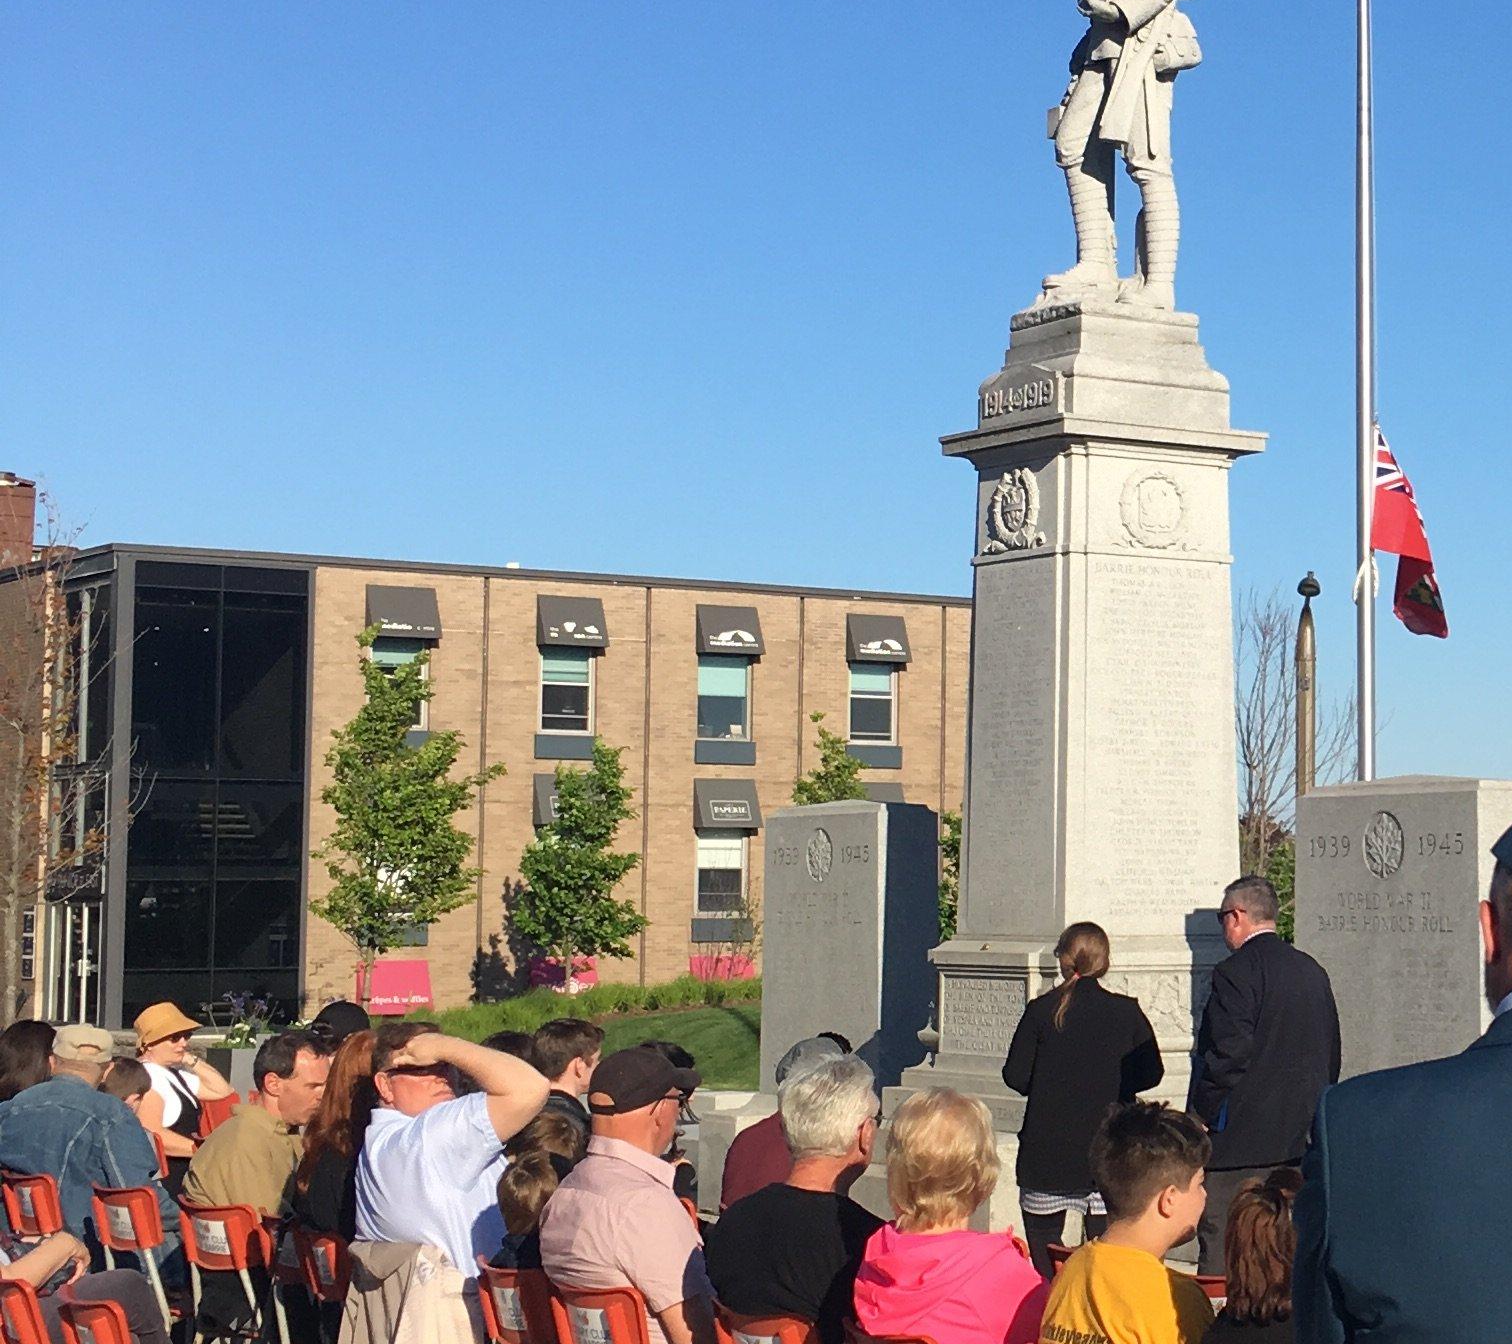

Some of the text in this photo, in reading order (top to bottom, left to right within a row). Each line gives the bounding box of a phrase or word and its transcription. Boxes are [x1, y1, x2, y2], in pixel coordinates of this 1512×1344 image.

[983, 378, 1054, 417] 1914 1919
[1310, 833, 1464, 858] 1939 1945
